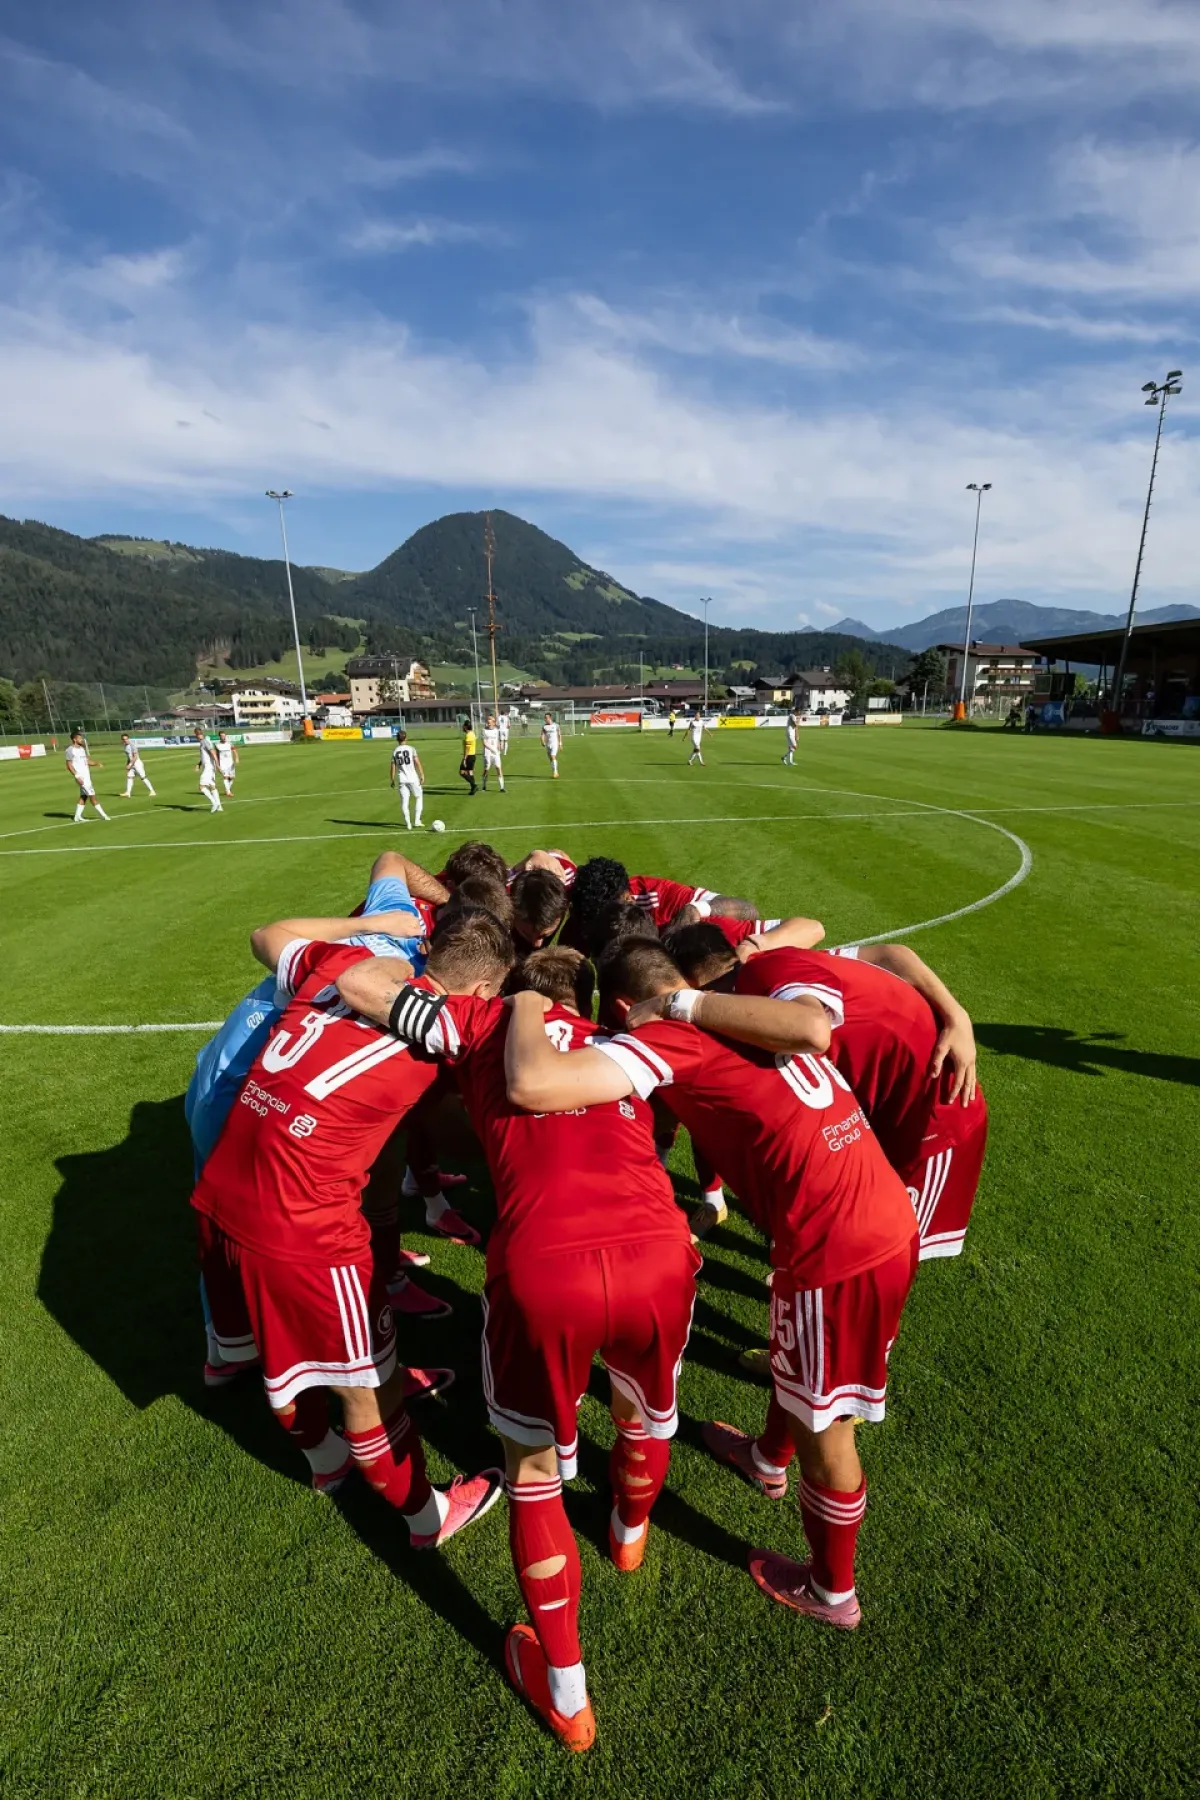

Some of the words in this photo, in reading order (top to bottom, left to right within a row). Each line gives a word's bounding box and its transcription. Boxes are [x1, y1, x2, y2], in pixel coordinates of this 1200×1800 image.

[240, 1091, 269, 1117] Group
[244, 1079, 292, 1115] Financial
[828, 1128, 861, 1152] Group
